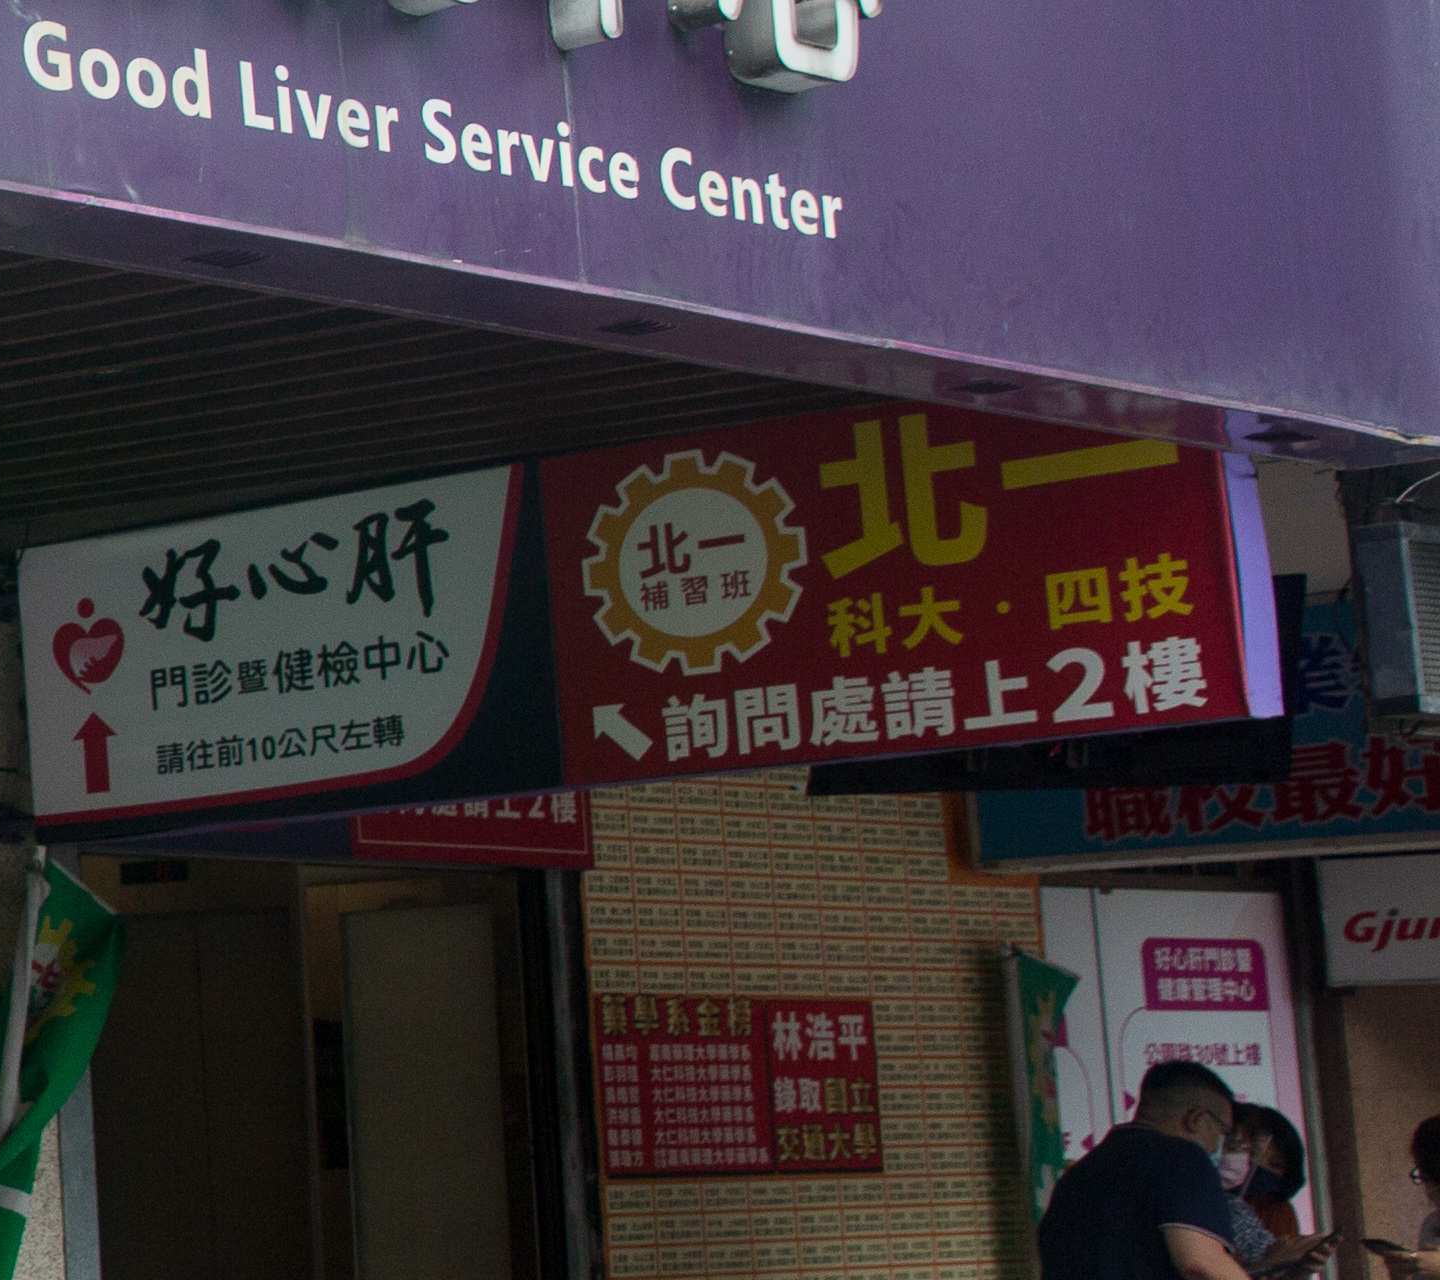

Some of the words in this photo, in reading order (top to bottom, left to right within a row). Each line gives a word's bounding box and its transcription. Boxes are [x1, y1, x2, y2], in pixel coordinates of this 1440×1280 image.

[21, 19, 213, 120] Good
[239, 59, 400, 154] Liver
[420, 98, 641, 200] Service
[658, 147, 843, 239] Center
[820, 413, 1179, 580] 北一
[138, 498, 450, 642] 好心肝
[638, 521, 747, 580] 北一
[639, 569, 753, 613] 補習班
[149, 630, 451, 712] 門診暨健檢中心
[661, 635, 1209, 763] 詢問處請上2樓
[156, 715, 405, 776] 請往前10公尺左轉
[771, 1009, 868, 1062] 林浩平
[776, 1121, 877, 1162] 交通大學
